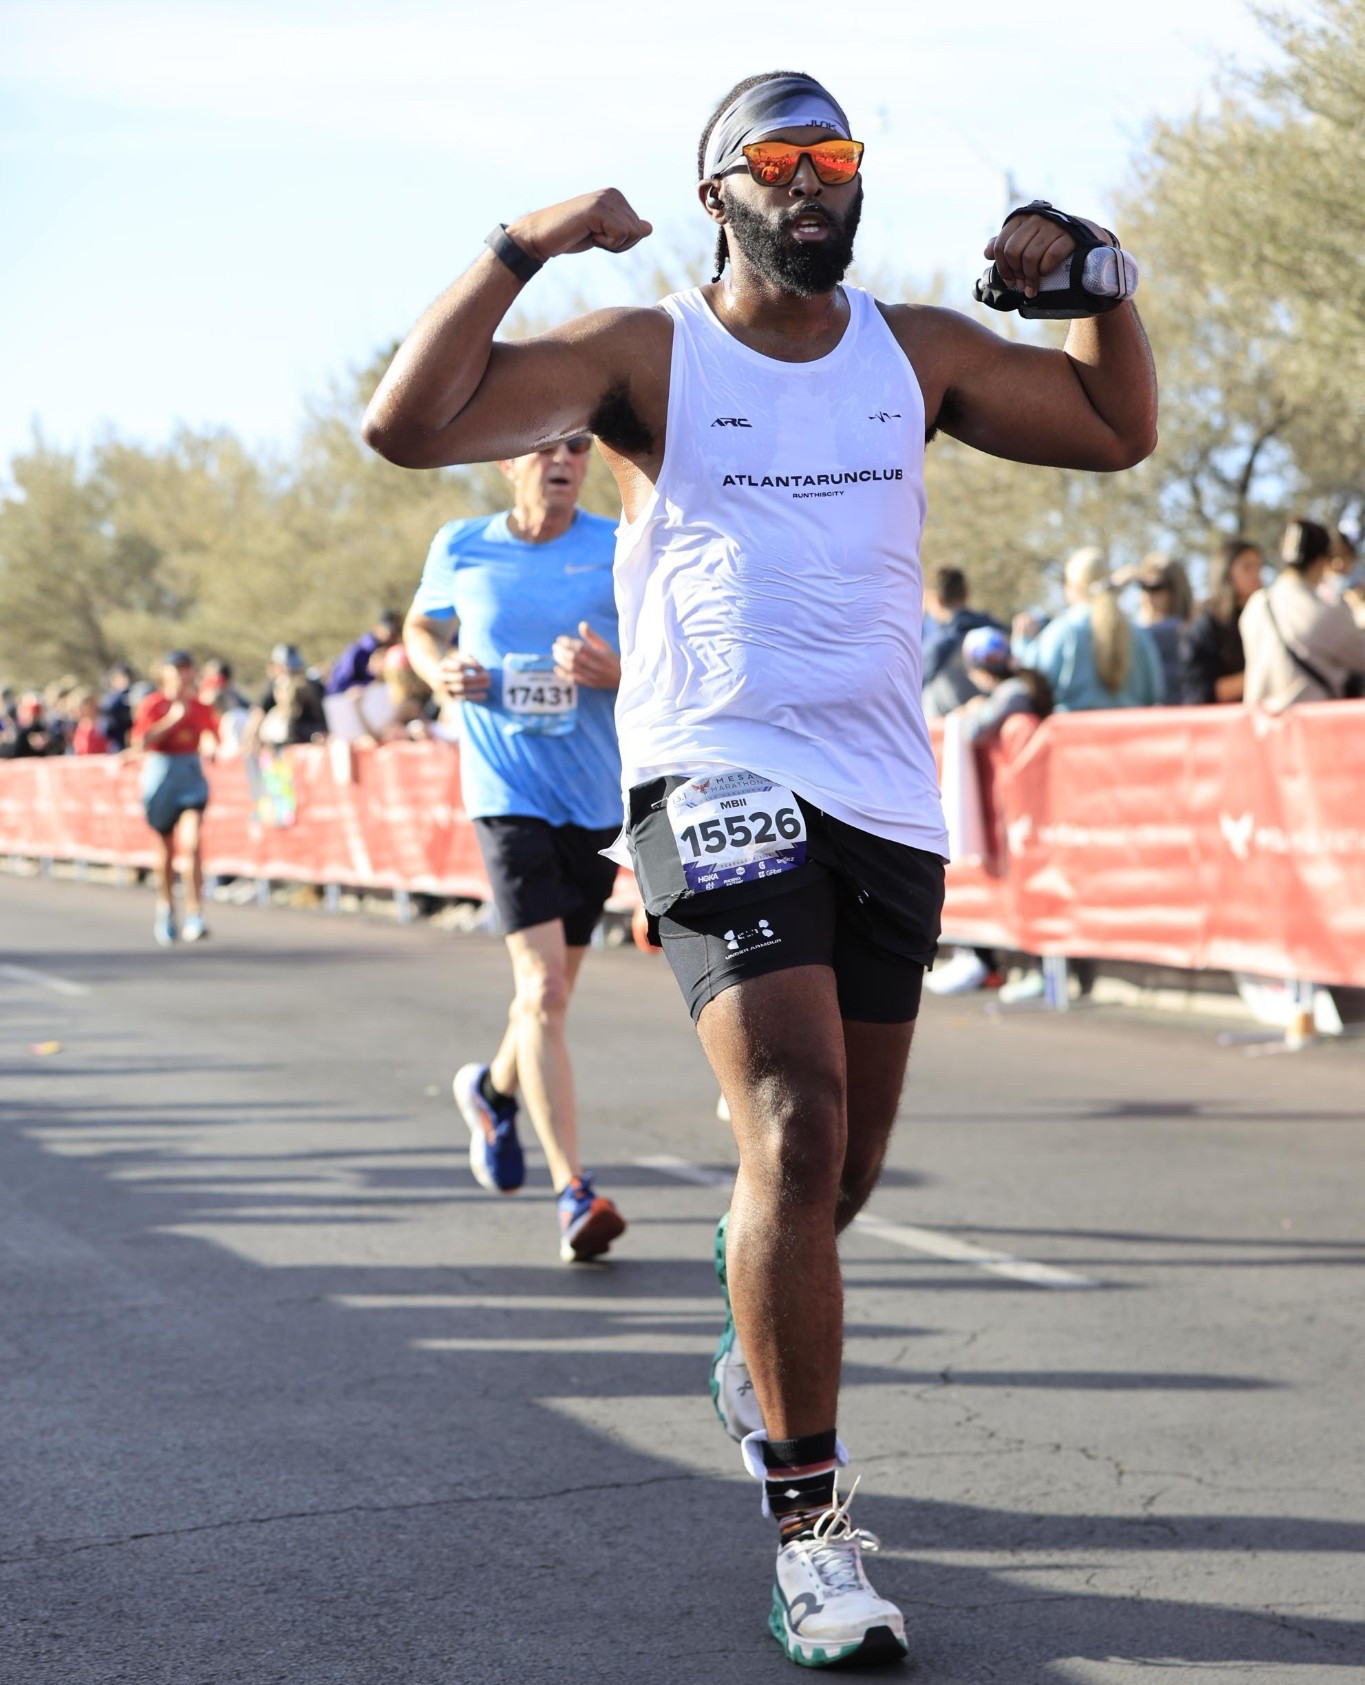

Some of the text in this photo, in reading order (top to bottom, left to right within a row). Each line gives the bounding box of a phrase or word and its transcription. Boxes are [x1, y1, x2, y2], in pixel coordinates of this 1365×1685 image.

[710, 417, 752, 428] ARC
[722, 468, 903, 488] ATLANTARUNCLUB
[792, 490, 844, 499] RUNTHISCITY
[508, 686, 573, 706] 17431
[716, 773, 755, 785] MESA
[711, 779, 764, 793] MARATHON
[719, 798, 747, 810] MBII
[680, 808, 801, 858] 15526
[697, 873, 719, 884] HOKA
[725, 938, 782, 960] UNDER ARMOUR
